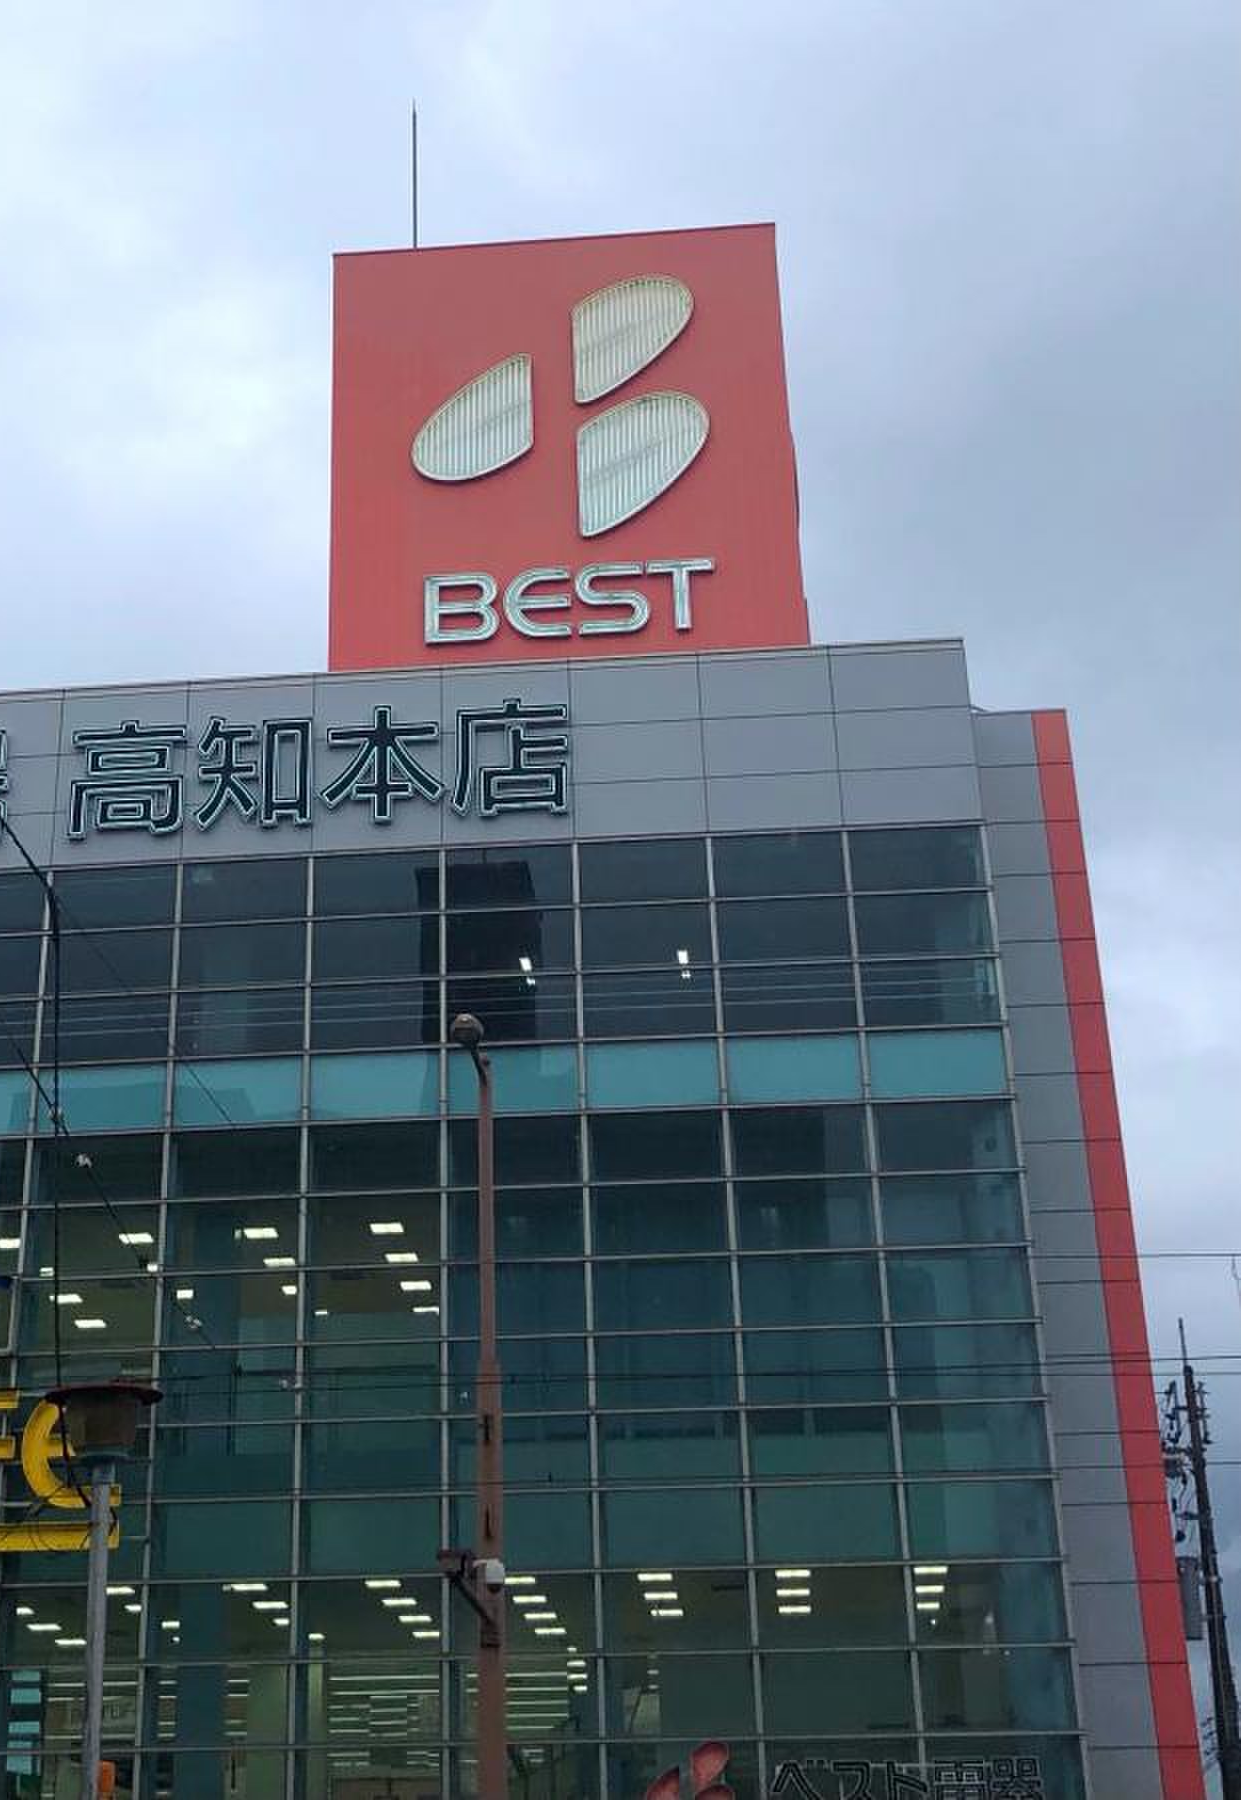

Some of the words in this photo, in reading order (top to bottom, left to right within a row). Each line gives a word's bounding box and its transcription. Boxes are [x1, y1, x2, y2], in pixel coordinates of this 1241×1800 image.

[423, 557, 716, 645] BEST
[67, 698, 569, 841] 高知本店
